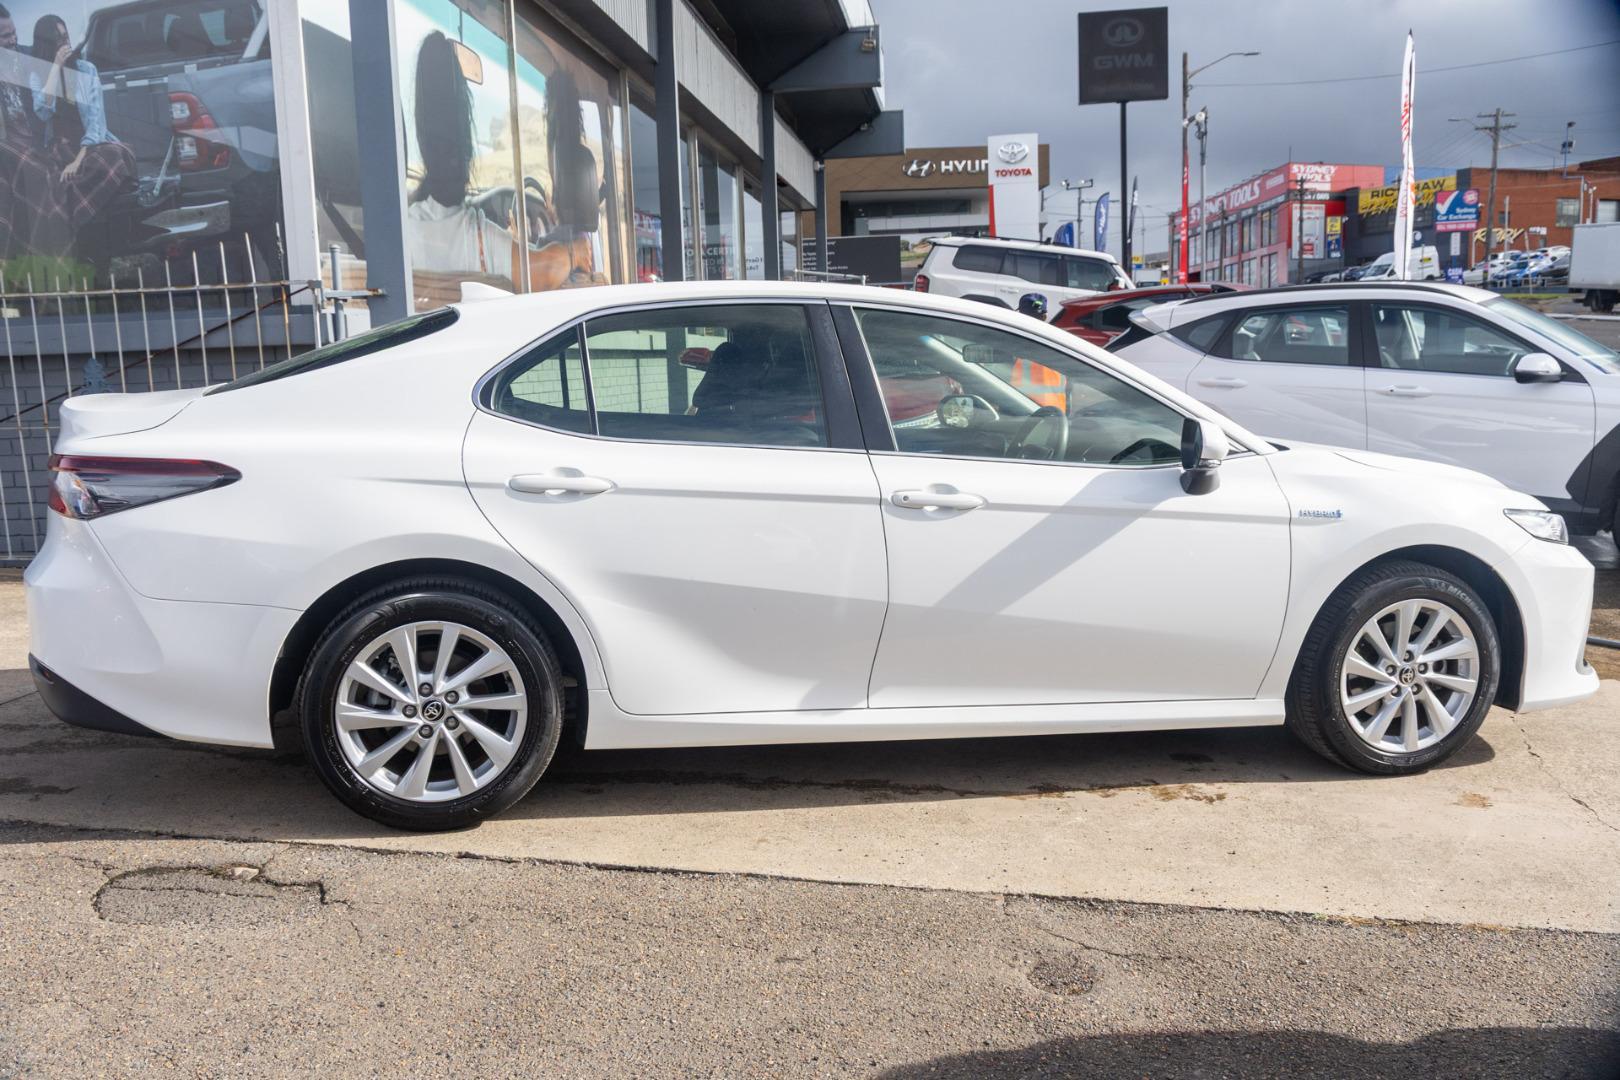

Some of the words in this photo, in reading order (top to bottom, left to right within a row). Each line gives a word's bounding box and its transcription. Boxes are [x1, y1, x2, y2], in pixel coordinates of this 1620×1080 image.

[1093, 53, 1155, 70] GWM
[995, 168, 1032, 178] TOYOTA
[1291, 164, 1337, 175] SYDNEY
[1230, 178, 1261, 208] TOOLS
